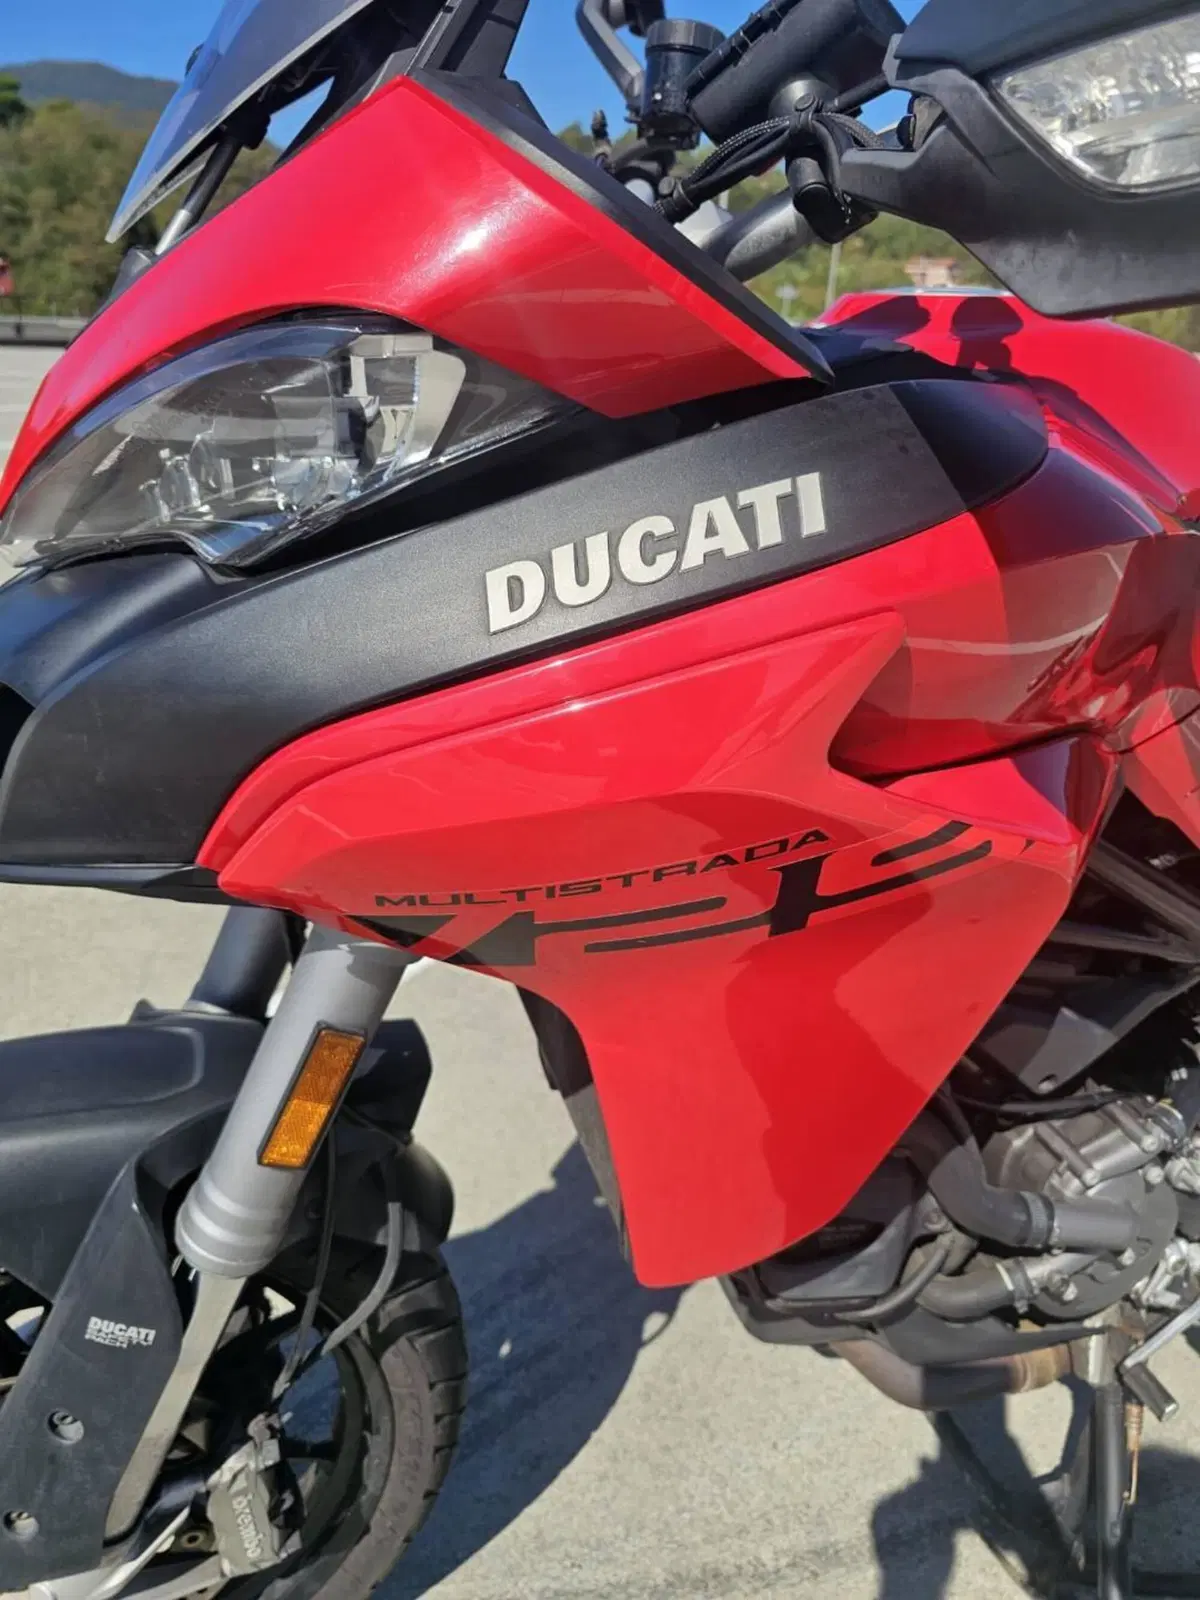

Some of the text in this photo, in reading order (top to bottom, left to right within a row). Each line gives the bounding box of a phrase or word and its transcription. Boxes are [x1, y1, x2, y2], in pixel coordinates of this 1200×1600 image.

[485, 471, 827, 635] DUCATI
[375, 827, 831, 907] MULTISTRADA
[88, 1315, 156, 1342] DUCATI
[231, 1492, 264, 1559] brembo
